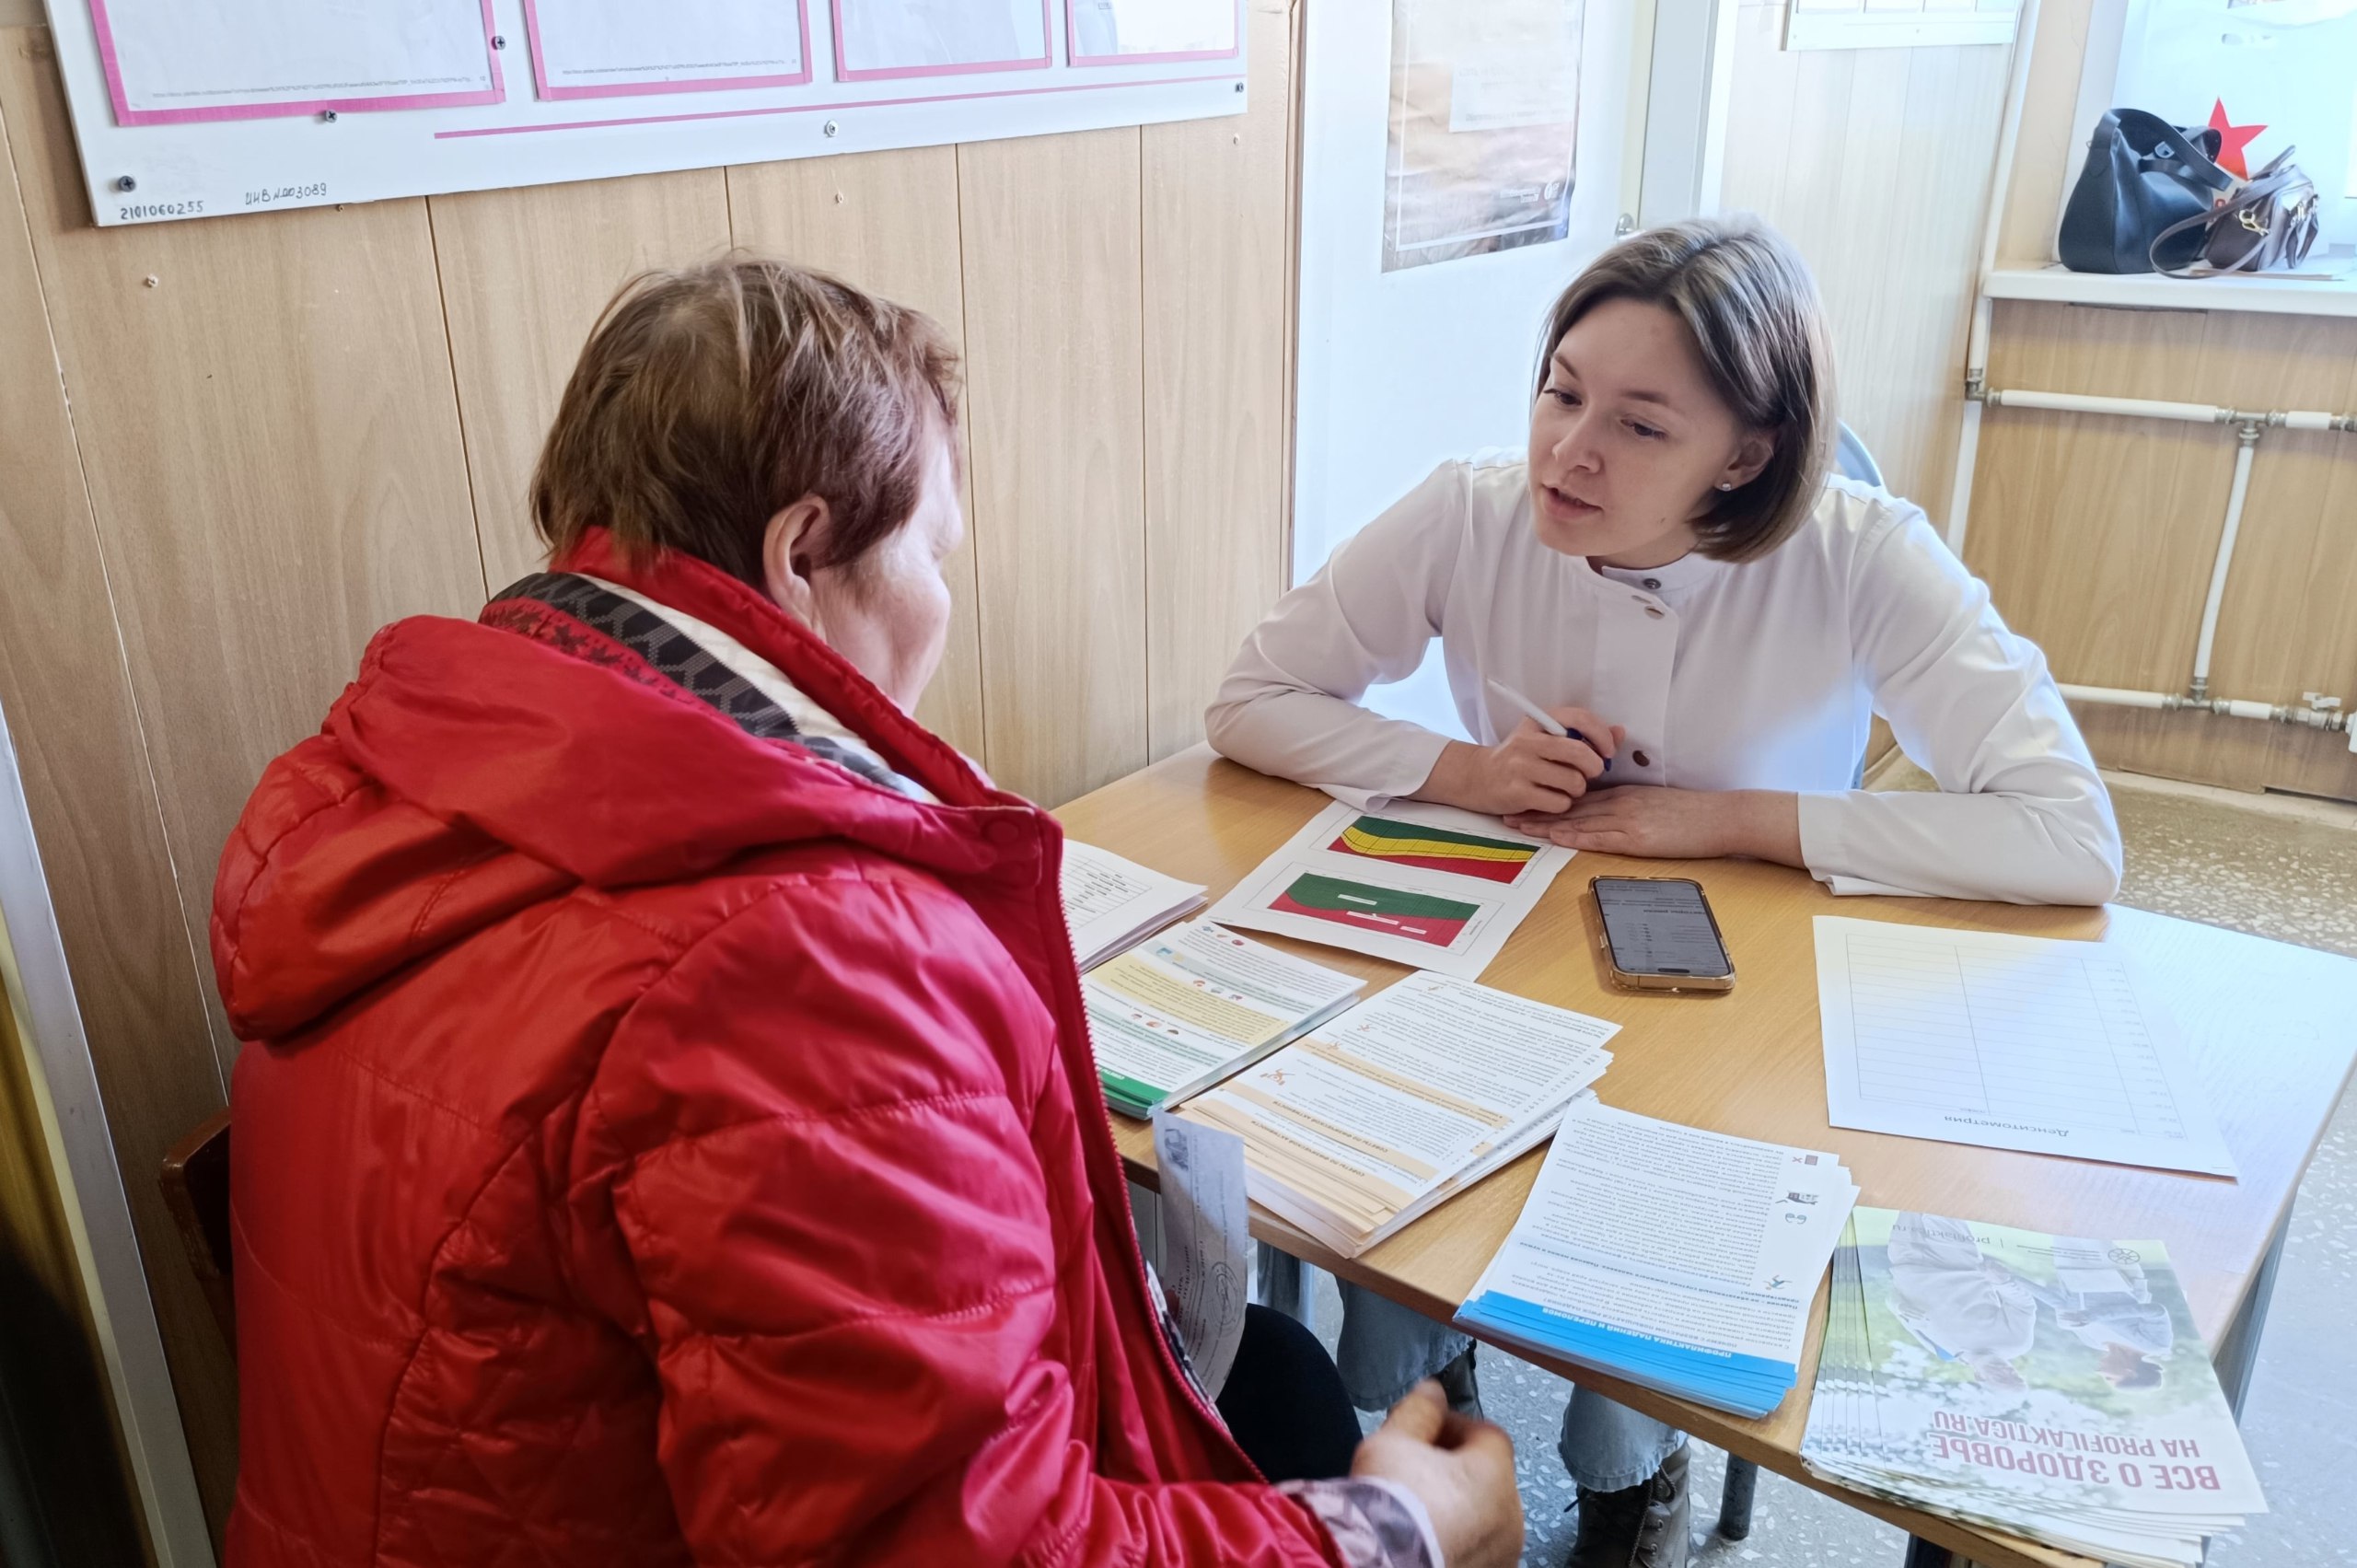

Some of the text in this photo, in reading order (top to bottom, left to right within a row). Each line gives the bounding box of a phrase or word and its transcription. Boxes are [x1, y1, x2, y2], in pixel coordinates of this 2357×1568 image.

[121, 200, 204, 220] 2101060255
[1944, 1115, 2070, 1138] Денситометрия
[1892, 1224, 1991, 1245] profilaktica.ru
[1540, 1307, 1596, 1326] ПЕРЕЛОМОВ
[1605, 1324, 1652, 1341] ПАДЕНИЙ
[1652, 1335, 1732, 1358] ПРОФИЛАКТИКА
[1933, 1411, 2200, 1458] НА PROFILAKTICA.RU
[1933, 1434, 2221, 1490] ВСЕ О ЗДОРОВЬЕ
